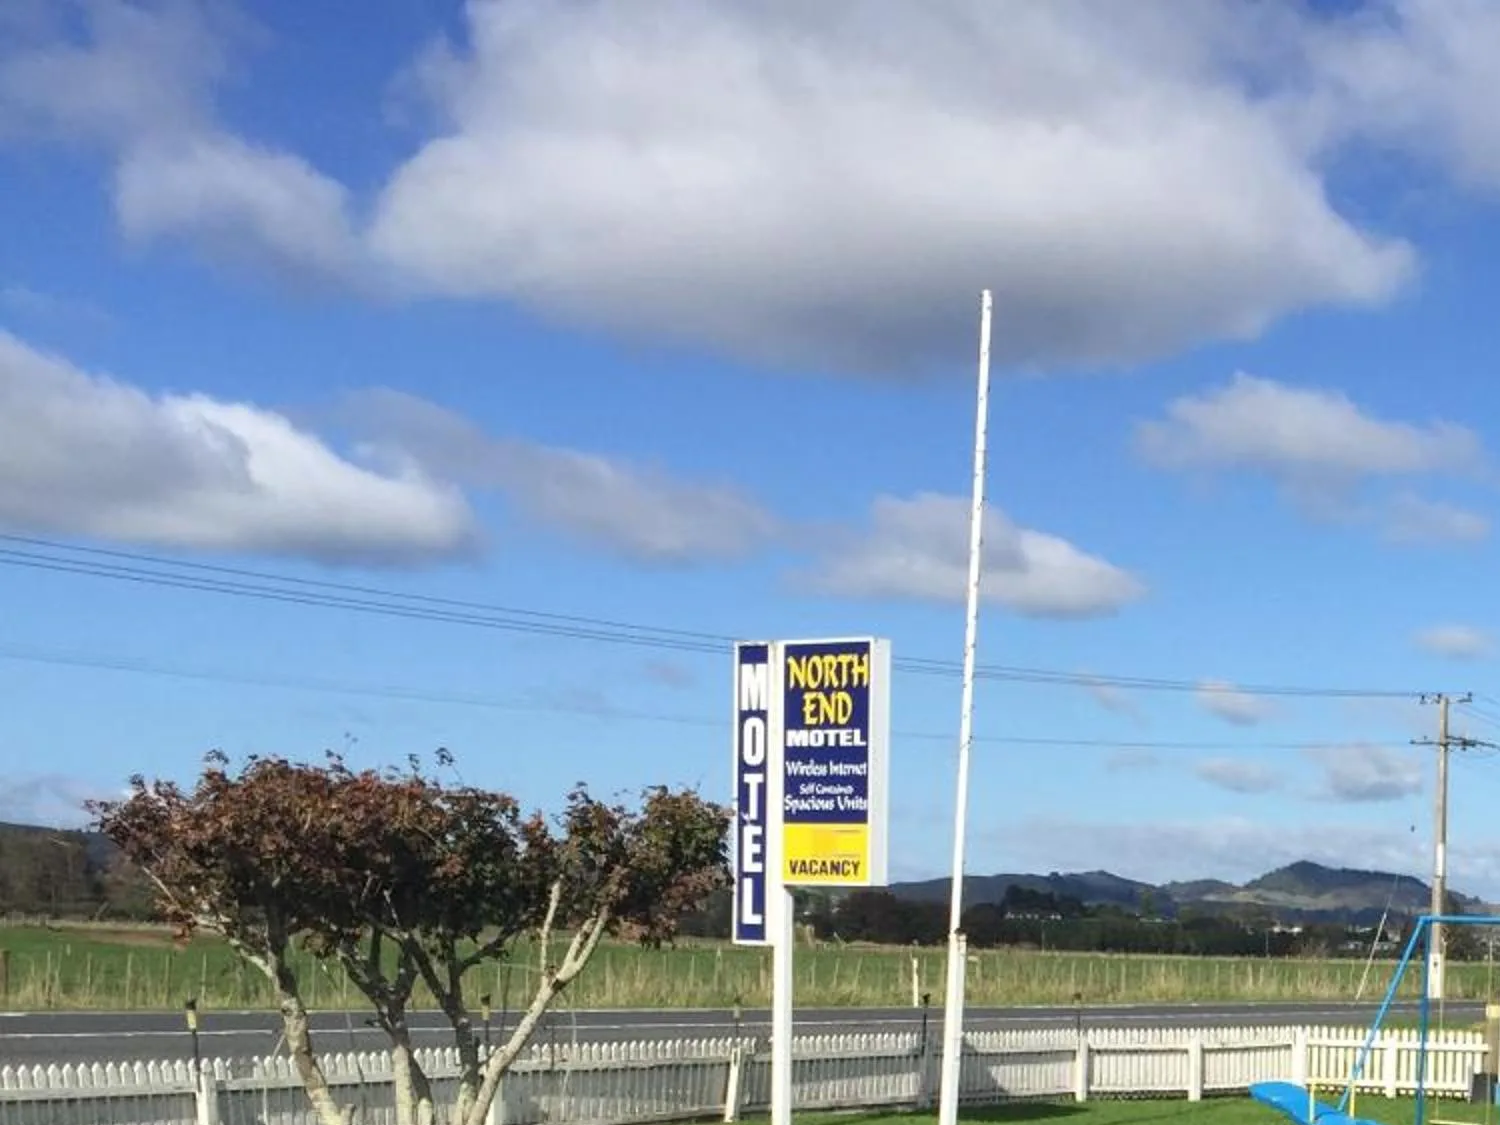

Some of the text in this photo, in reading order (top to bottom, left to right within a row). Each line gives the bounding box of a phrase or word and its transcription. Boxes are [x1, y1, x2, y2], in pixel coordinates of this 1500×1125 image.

[787, 653, 869, 689] NORTH
[802, 690, 853, 725] END
[785, 728, 867, 747] MOTEL
[785, 758, 867, 776] Wireless Internet
[741, 663, 768, 925] MOTEL
[784, 794, 868, 815] Spacious Units
[789, 859, 861, 877] VACANCY
